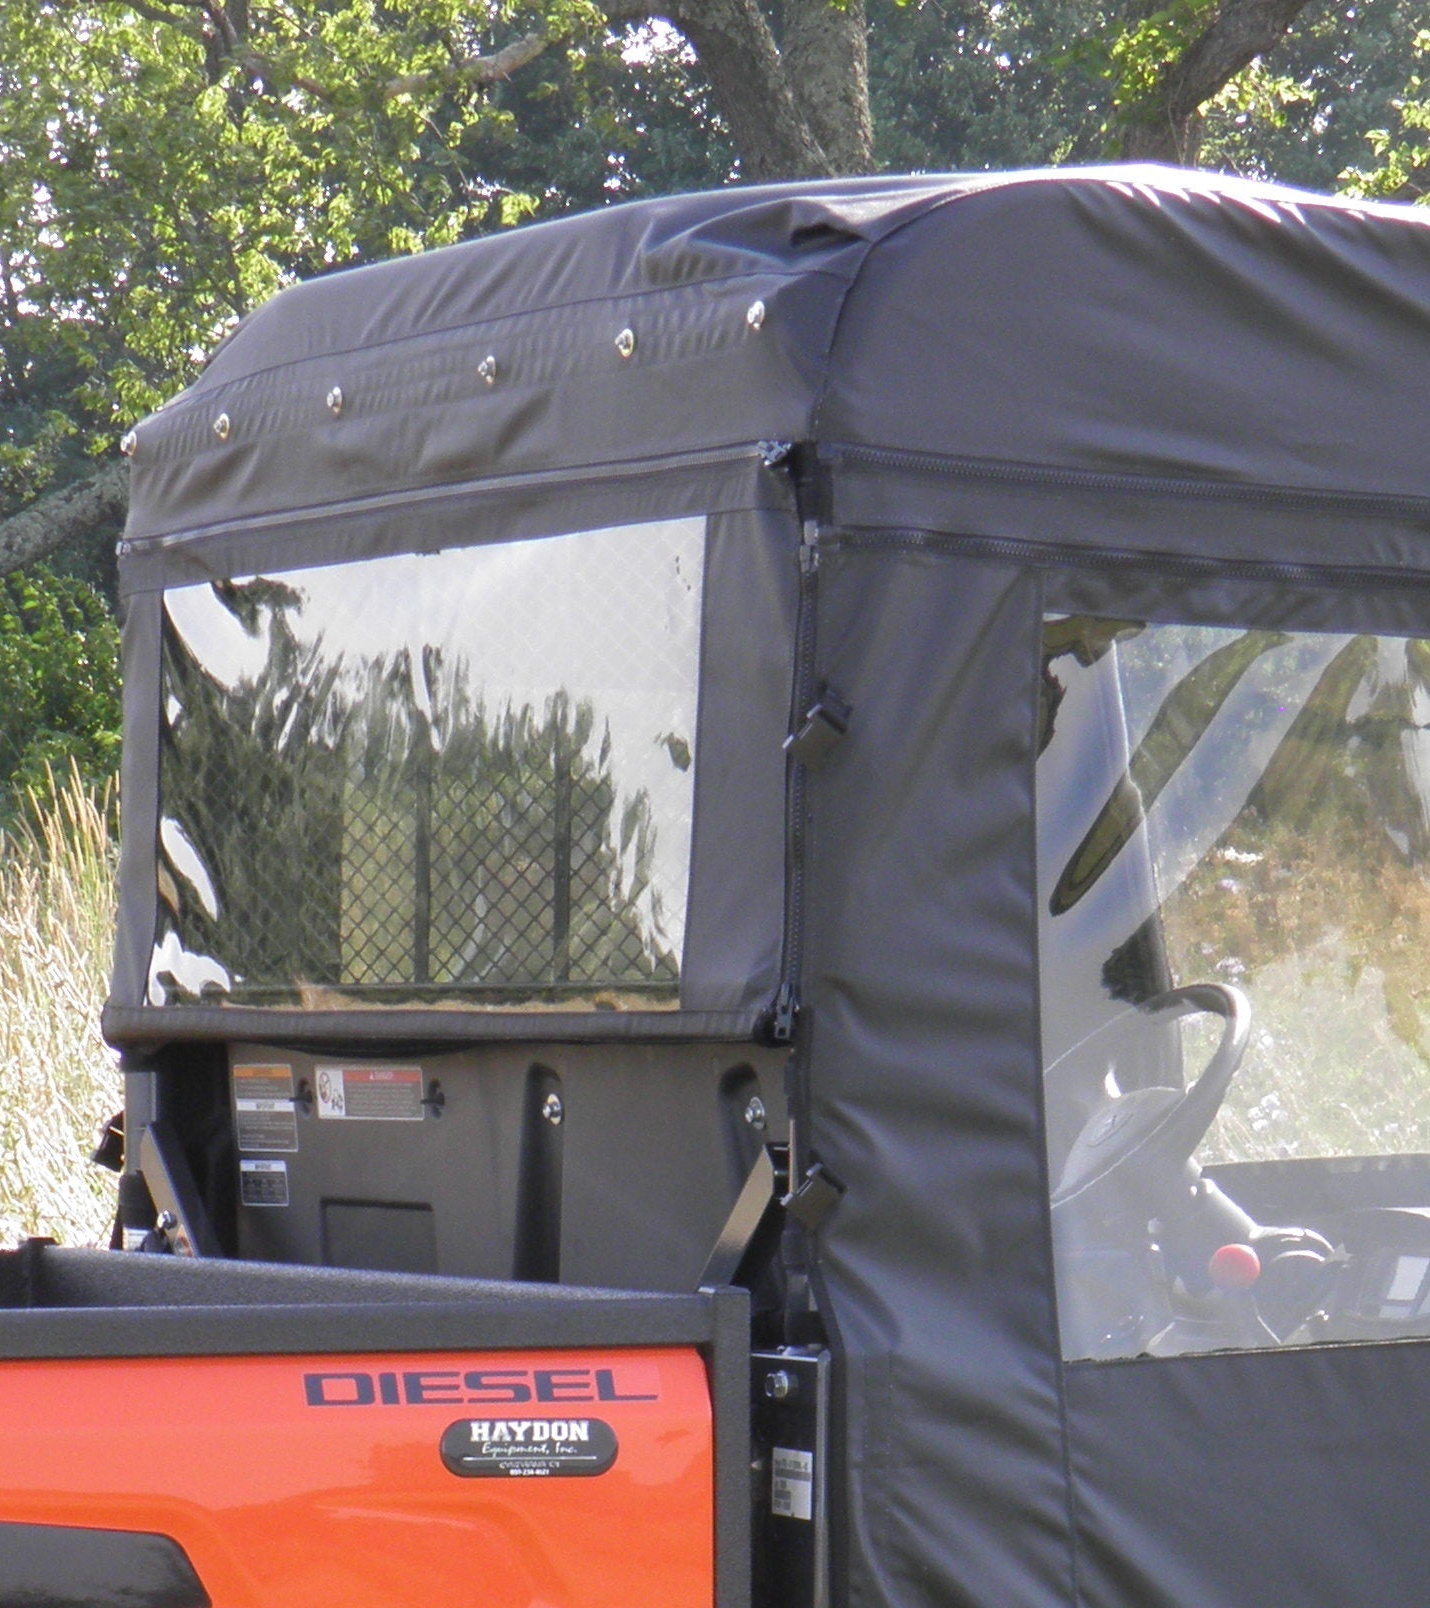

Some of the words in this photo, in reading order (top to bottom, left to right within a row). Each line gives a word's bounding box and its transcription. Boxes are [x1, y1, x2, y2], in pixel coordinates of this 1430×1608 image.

[303, 1369, 658, 1406] DIESEL
[469, 1420, 590, 1442] HAYDON
[482, 1441, 550, 1458] Equipment,
[555, 1441, 578, 1454] Inc.
